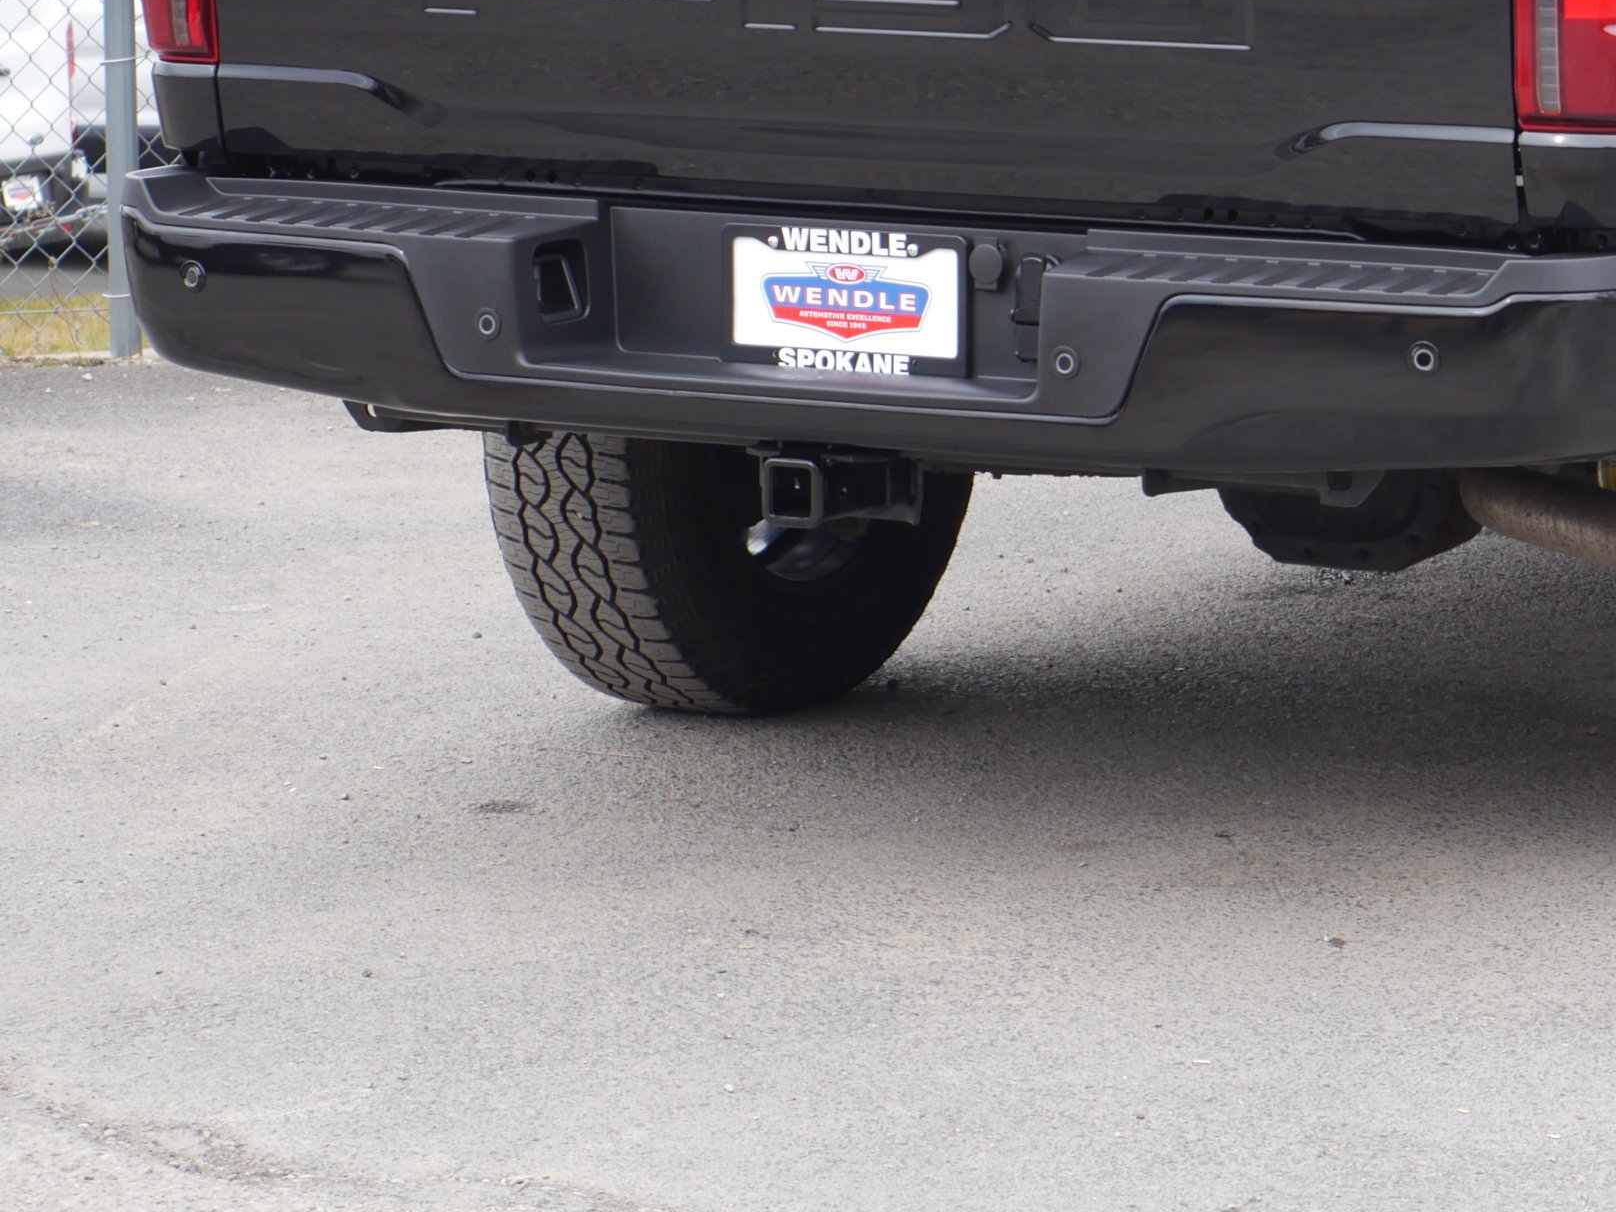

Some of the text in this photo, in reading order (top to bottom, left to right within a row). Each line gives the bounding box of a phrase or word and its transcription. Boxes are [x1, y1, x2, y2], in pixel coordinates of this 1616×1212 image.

[781, 226, 909, 257] WENDLE
[771, 284, 917, 312] WENDLE
[777, 347, 910, 376] SPOKANE
